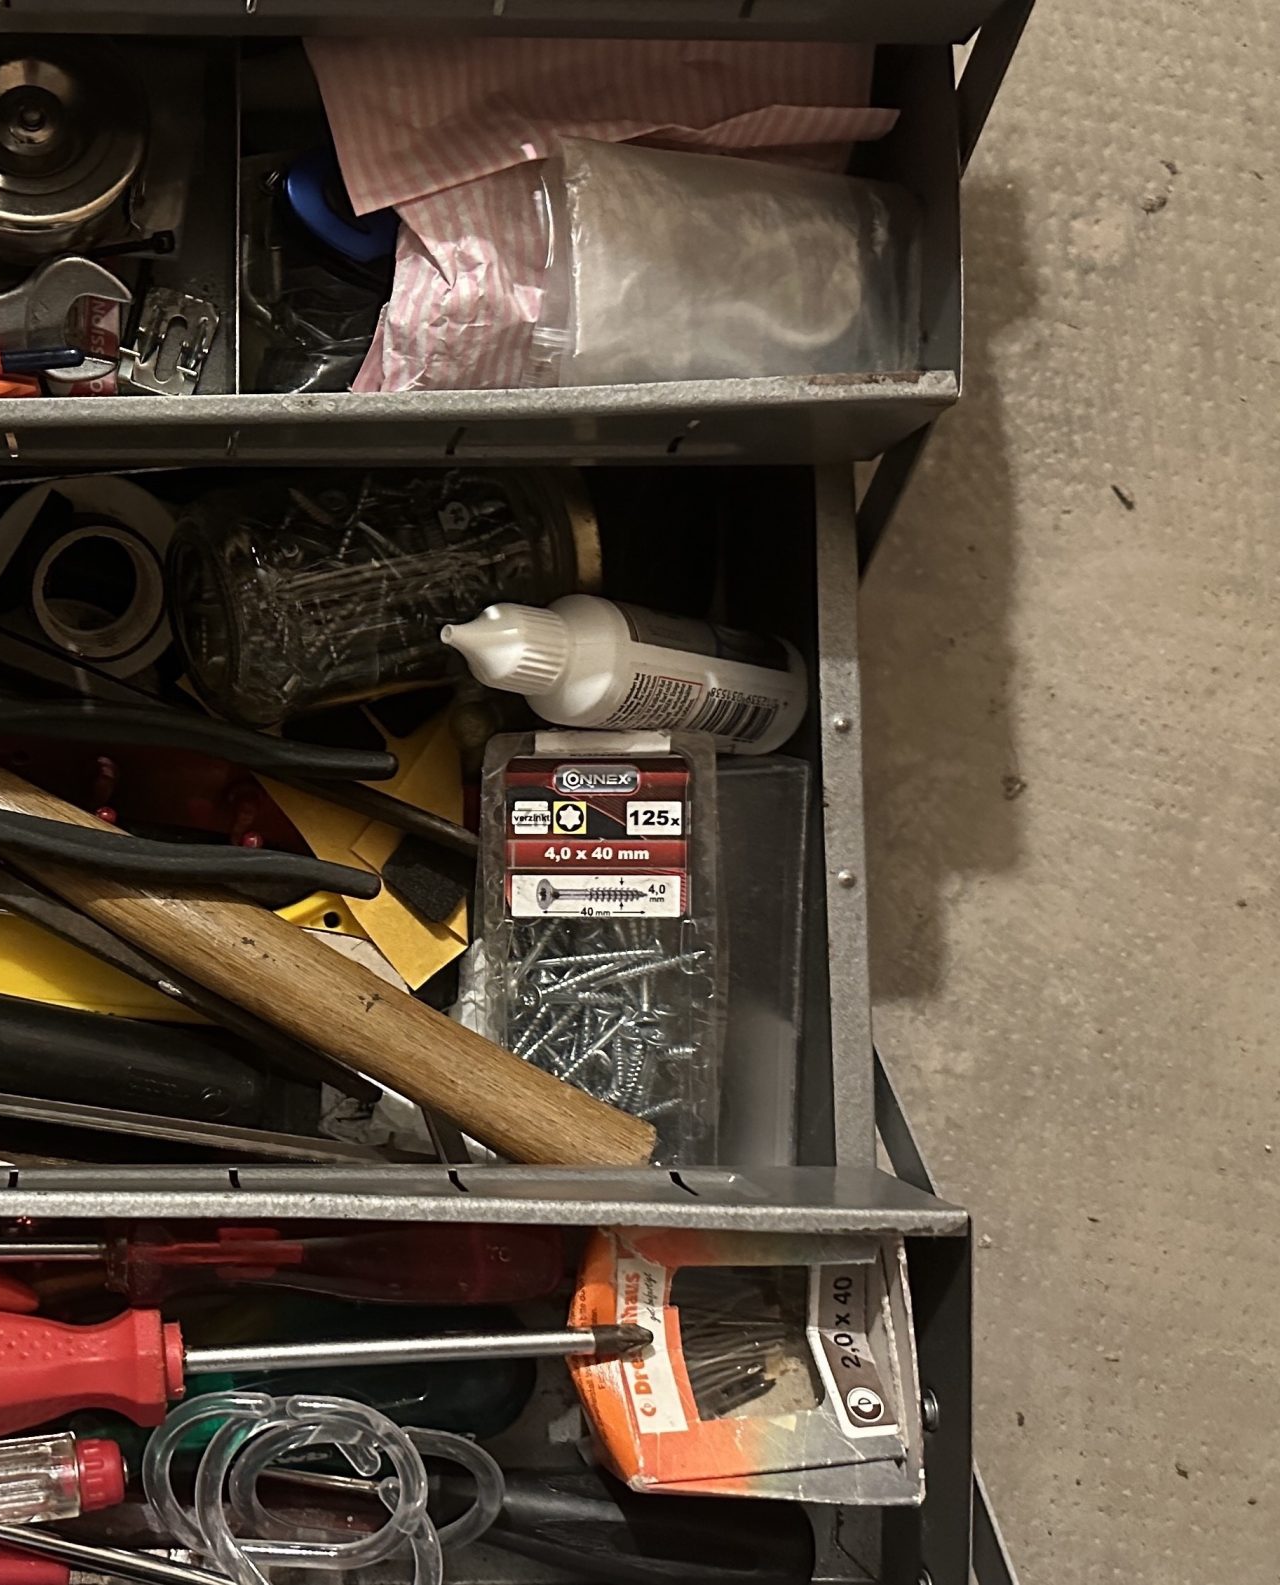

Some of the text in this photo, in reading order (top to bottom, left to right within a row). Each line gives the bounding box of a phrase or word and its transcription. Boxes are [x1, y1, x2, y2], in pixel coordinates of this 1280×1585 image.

[514, 813, 550, 822] verzinkt
[544, 847, 649, 861] 4,0 x 40 mm
[648, 884, 665, 896] 4,0
[580, 907, 594, 916] 40
[833, 1276, 861, 1369] 2,0 x 40
